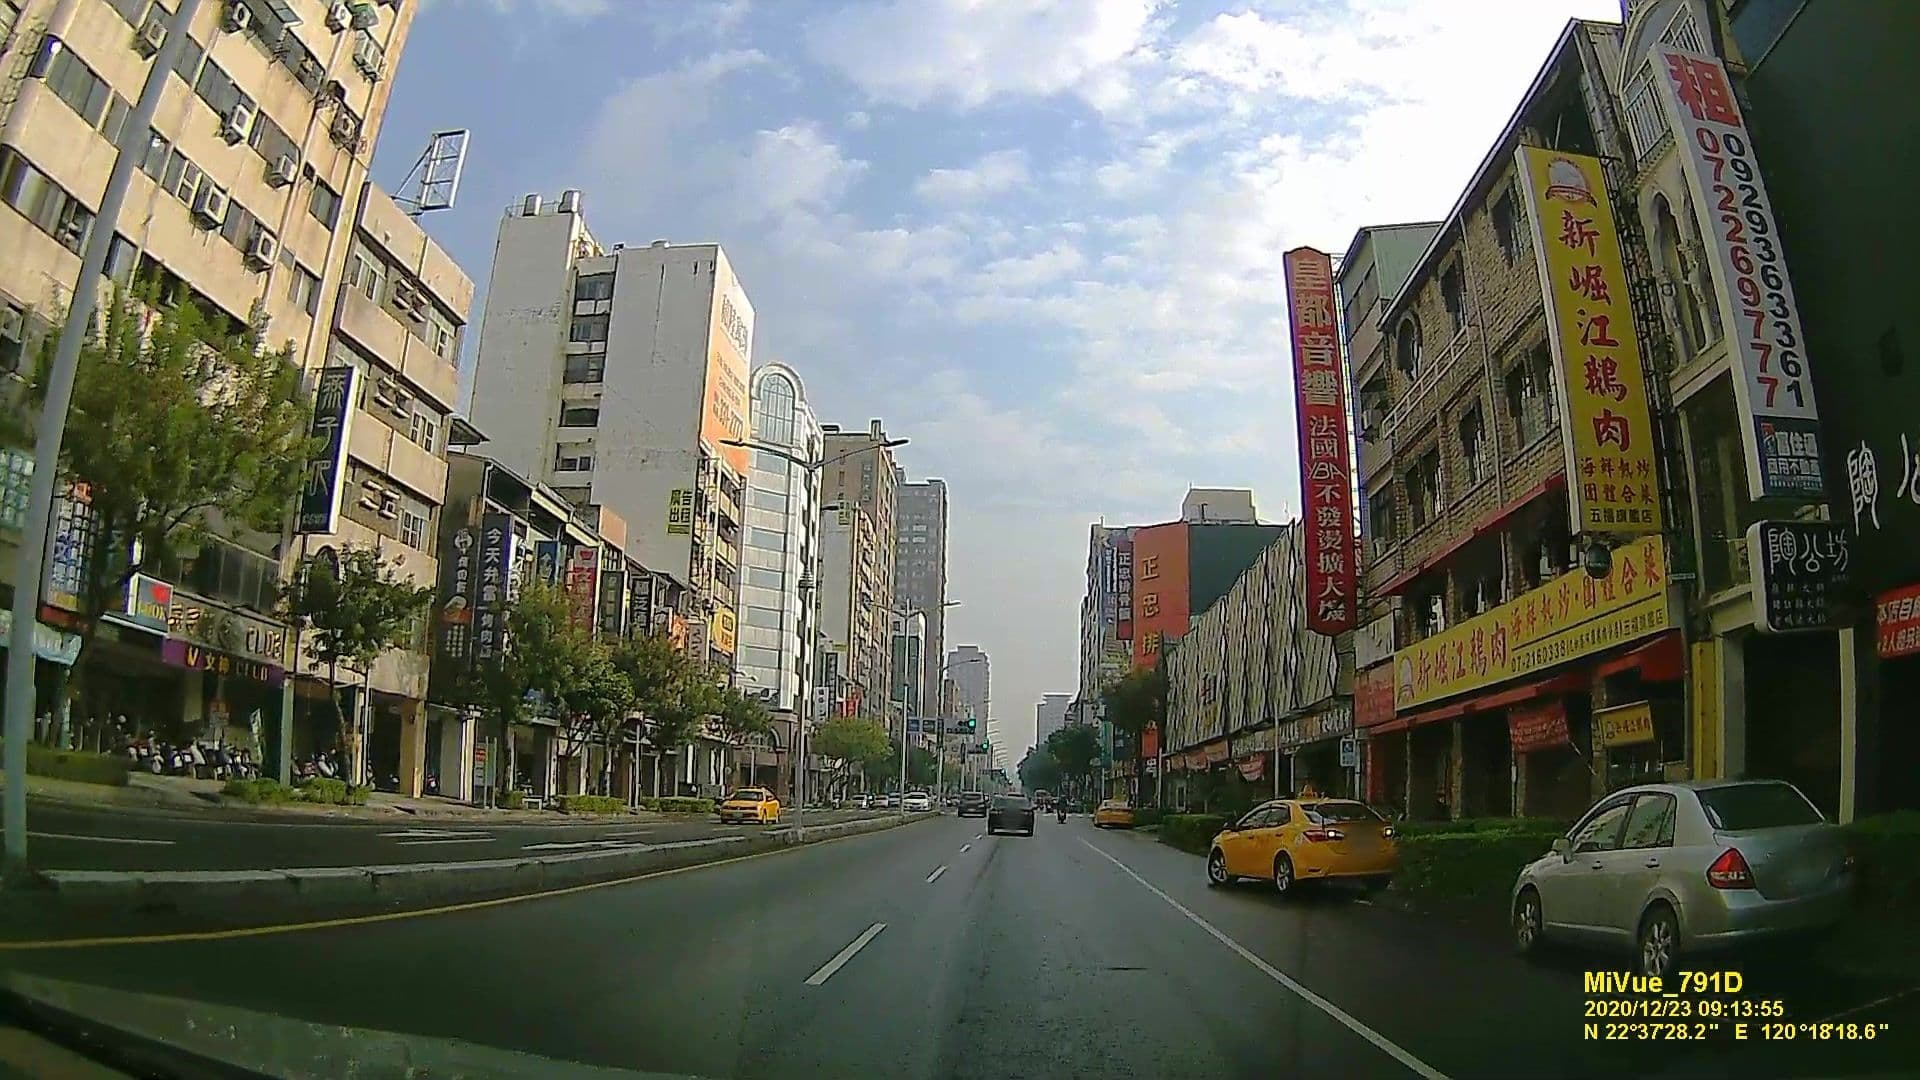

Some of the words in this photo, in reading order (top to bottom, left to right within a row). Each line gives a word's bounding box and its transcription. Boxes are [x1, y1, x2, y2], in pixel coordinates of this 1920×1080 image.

[1664, 53, 1740, 127] 租
[1296, 260, 1337, 406] 皇都音響
[1696, 127, 1777, 408] 072269777
[1723, 133, 1804, 408] 0929363361
